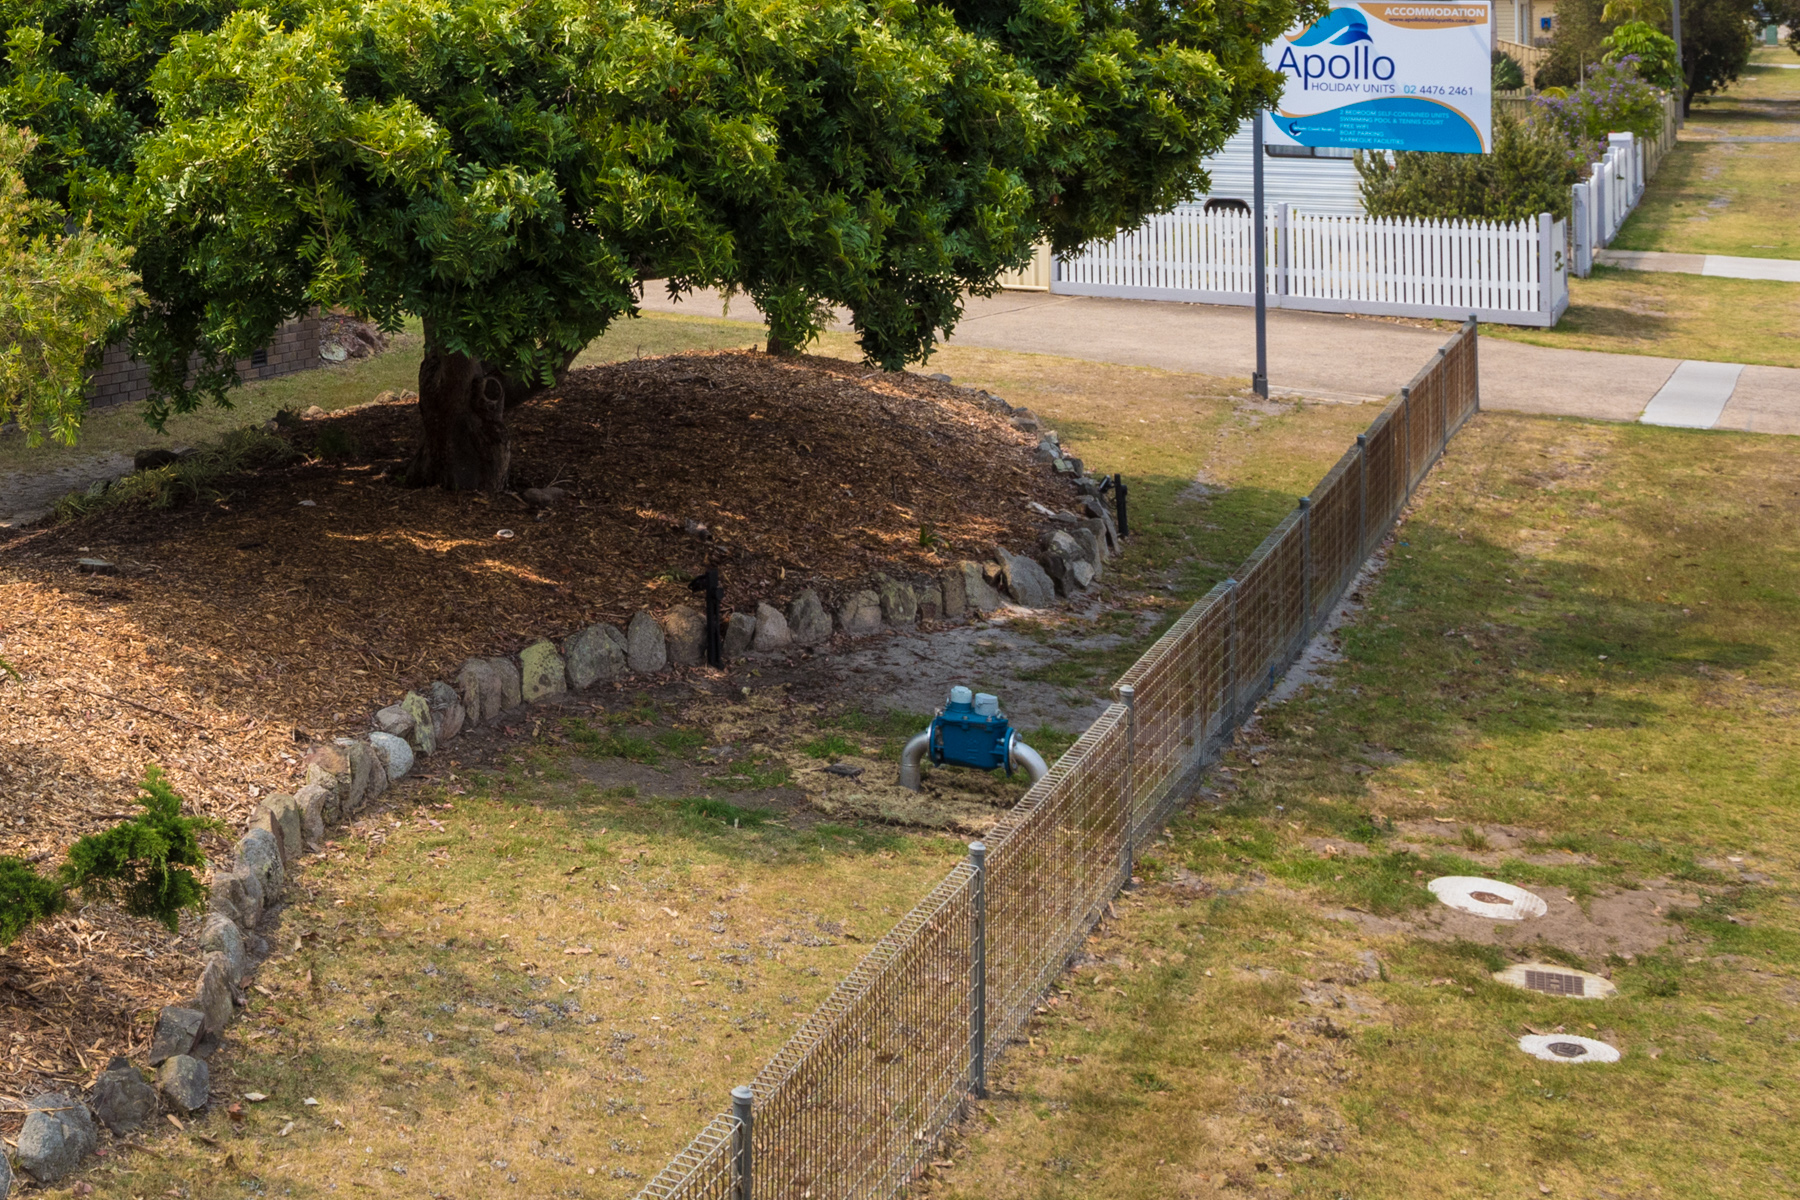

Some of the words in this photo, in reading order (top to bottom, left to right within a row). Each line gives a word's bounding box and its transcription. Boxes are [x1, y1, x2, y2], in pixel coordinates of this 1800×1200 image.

[1384, 7, 1485, 17] ACCOMMODATION
[1277, 45, 1395, 90] Apollo
[1311, 82, 1360, 93] HOLIDAY
[1363, 84, 1395, 94] UNITS
[1403, 85, 1416, 94] 02
[1419, 85, 1445, 95] 4476
[1448, 86, 1473, 96] 2461
[1377, 110, 1430, 118] SELF-CONTAINED
